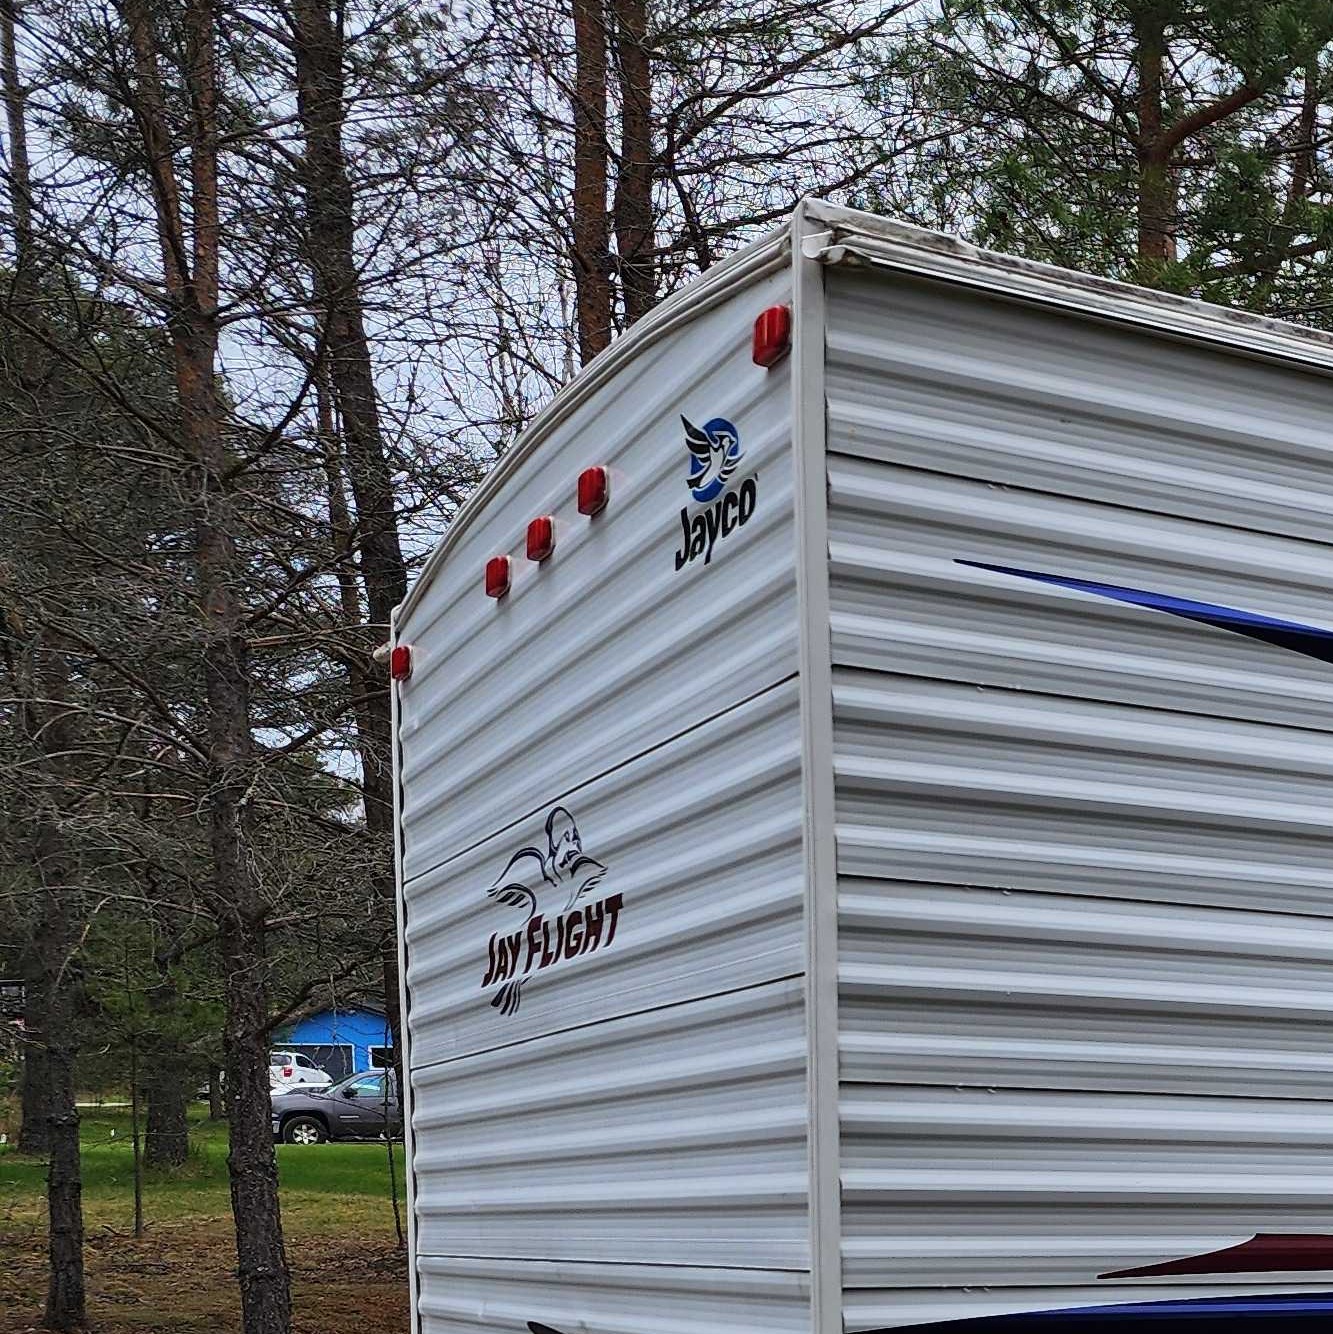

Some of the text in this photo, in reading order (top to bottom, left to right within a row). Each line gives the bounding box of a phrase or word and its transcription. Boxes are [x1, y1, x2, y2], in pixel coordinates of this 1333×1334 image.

[675, 478, 757, 571] Jayco
[481, 892, 624, 988] JAY FLIGHT
